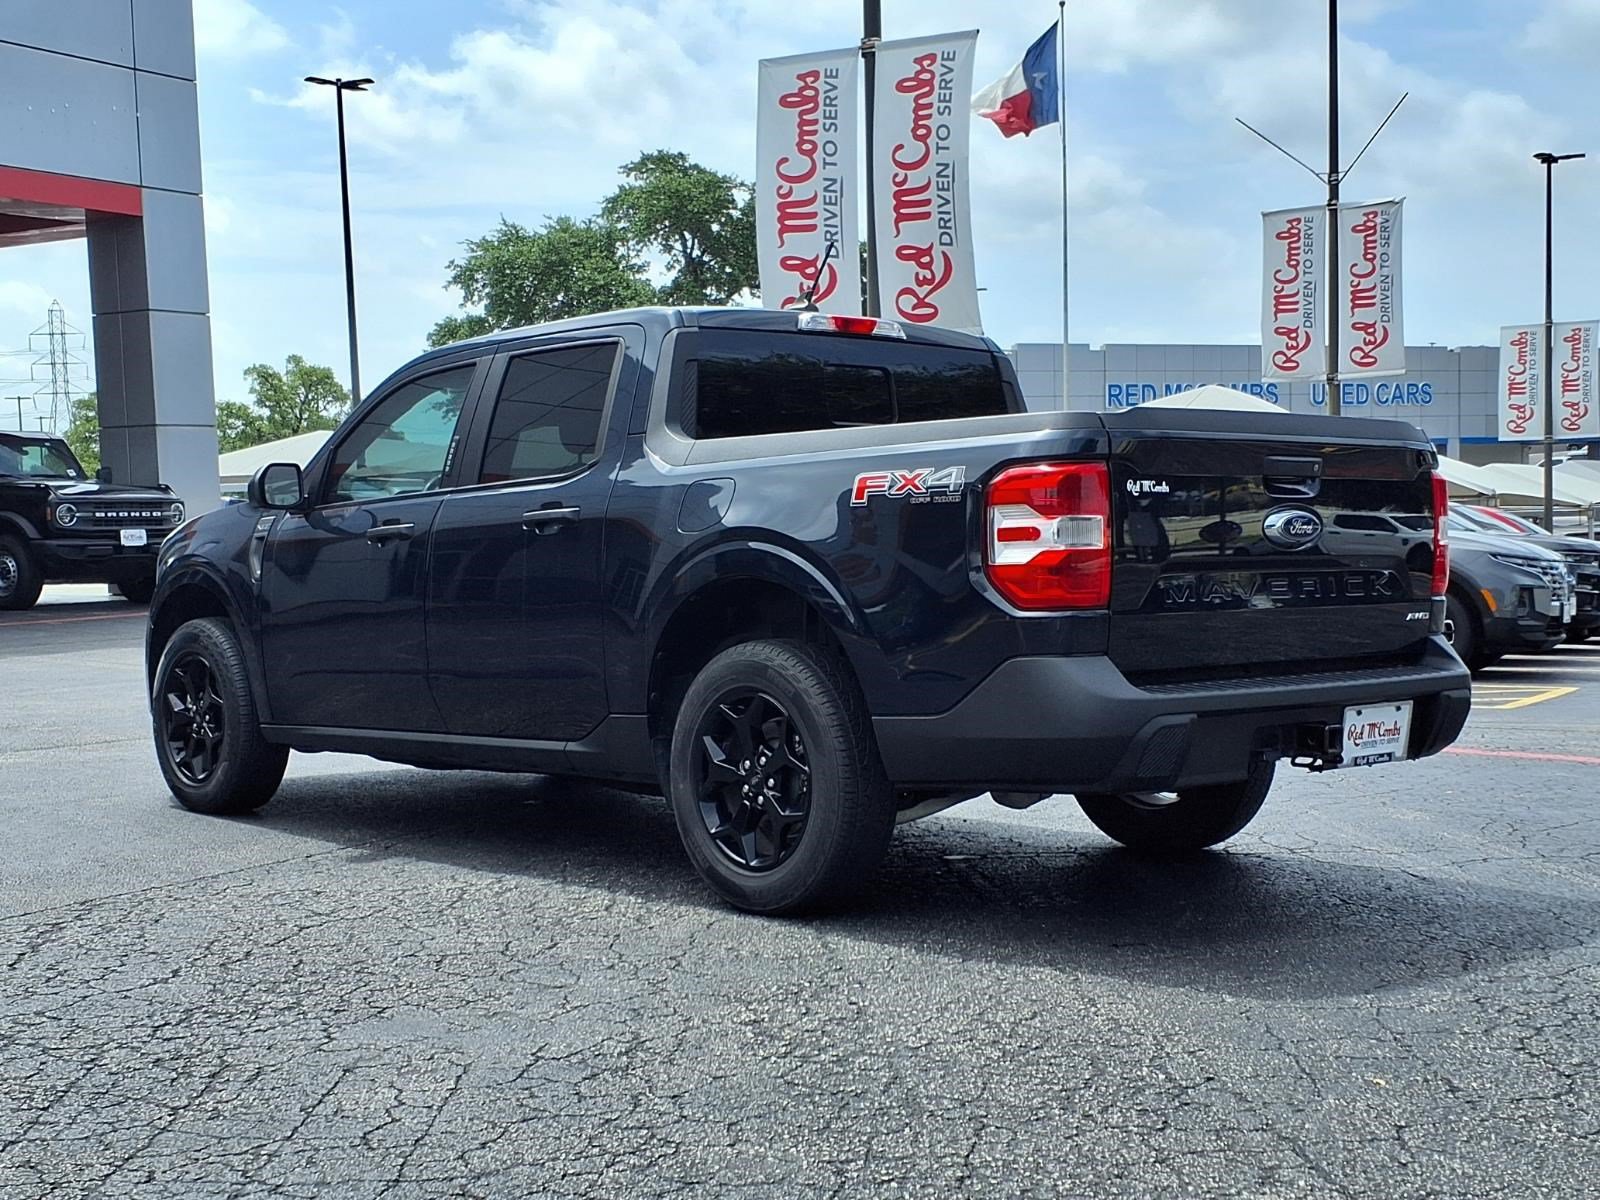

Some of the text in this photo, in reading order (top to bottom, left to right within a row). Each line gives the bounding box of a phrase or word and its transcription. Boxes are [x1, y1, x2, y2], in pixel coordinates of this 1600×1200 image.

[775, 69, 821, 248] McCombs
[822, 67, 841, 259] DRIVEN TO SERVE
[891, 52, 953, 323] Red McCombs
[935, 50, 956, 247] DRIVEN TO SERVE
[1272, 217, 1311, 371] Red McCombs
[1303, 216, 1314, 329] DRIVEN TO SERVE
[1349, 210, 1389, 368] Red McCombs
[1380, 209, 1391, 323] DRIVEN TO SERVE
[1506, 331, 1534, 434] Red McCombs
[1529, 331, 1537, 358] SERVE
[1529, 359, 1537, 371] TO
[1560, 327, 1588, 432] Red McCombs
[1582, 327, 1591, 403] DRIVEN TO SERVE
[1107, 383, 1157, 407] RED
[1311, 383, 1369, 405] UED
[1376, 382, 1433, 405] CARS
[850, 465, 966, 507] FX4
[1126, 479, 1170, 496] Red McCombs
[1290, 517, 1315, 535] Ford
[1163, 574, 1393, 604] MAVERICK
[1405, 611, 1430, 621] AWD
[1347, 720, 1401, 747] Red McCombs
